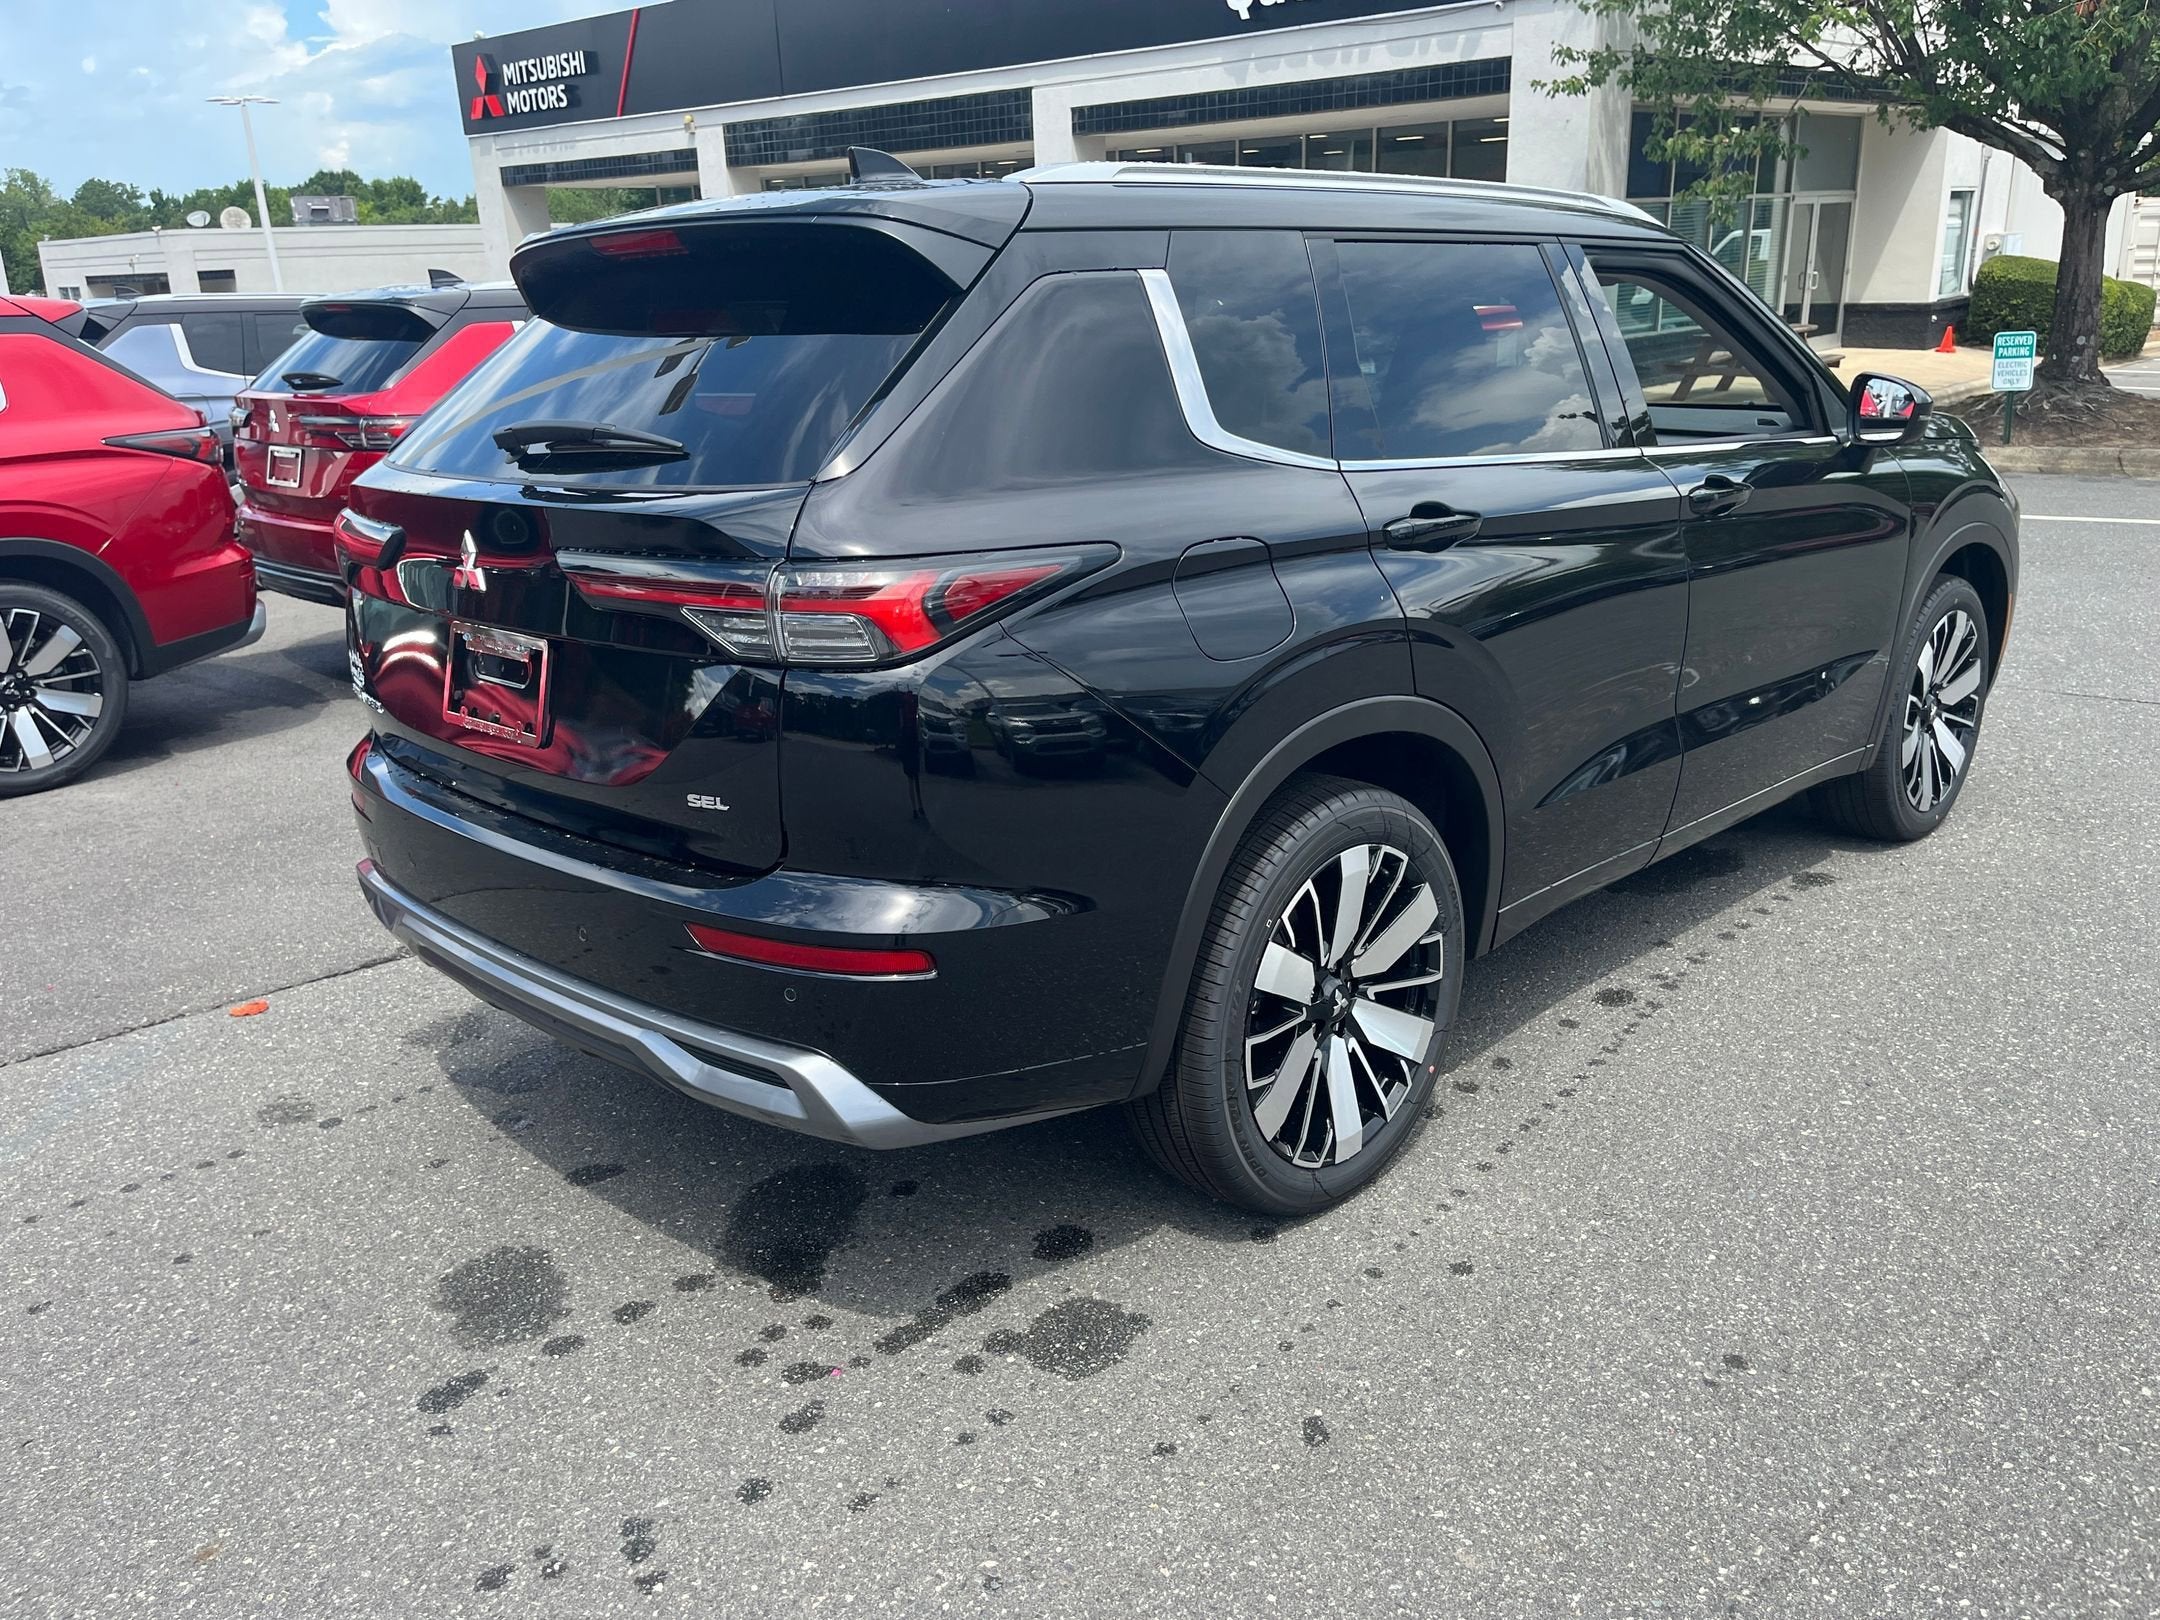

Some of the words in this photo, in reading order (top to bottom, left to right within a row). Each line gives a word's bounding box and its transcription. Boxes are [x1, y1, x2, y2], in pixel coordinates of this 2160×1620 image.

[502, 50, 586, 86] MITSUBISHI
[506, 84, 568, 115] MOTORS
[1997, 335, 2033, 346] RESERVED
[1998, 346, 2030, 357] PARKING
[1997, 369, 2028, 377] VEHICLES
[686, 793, 730, 811] SEL
